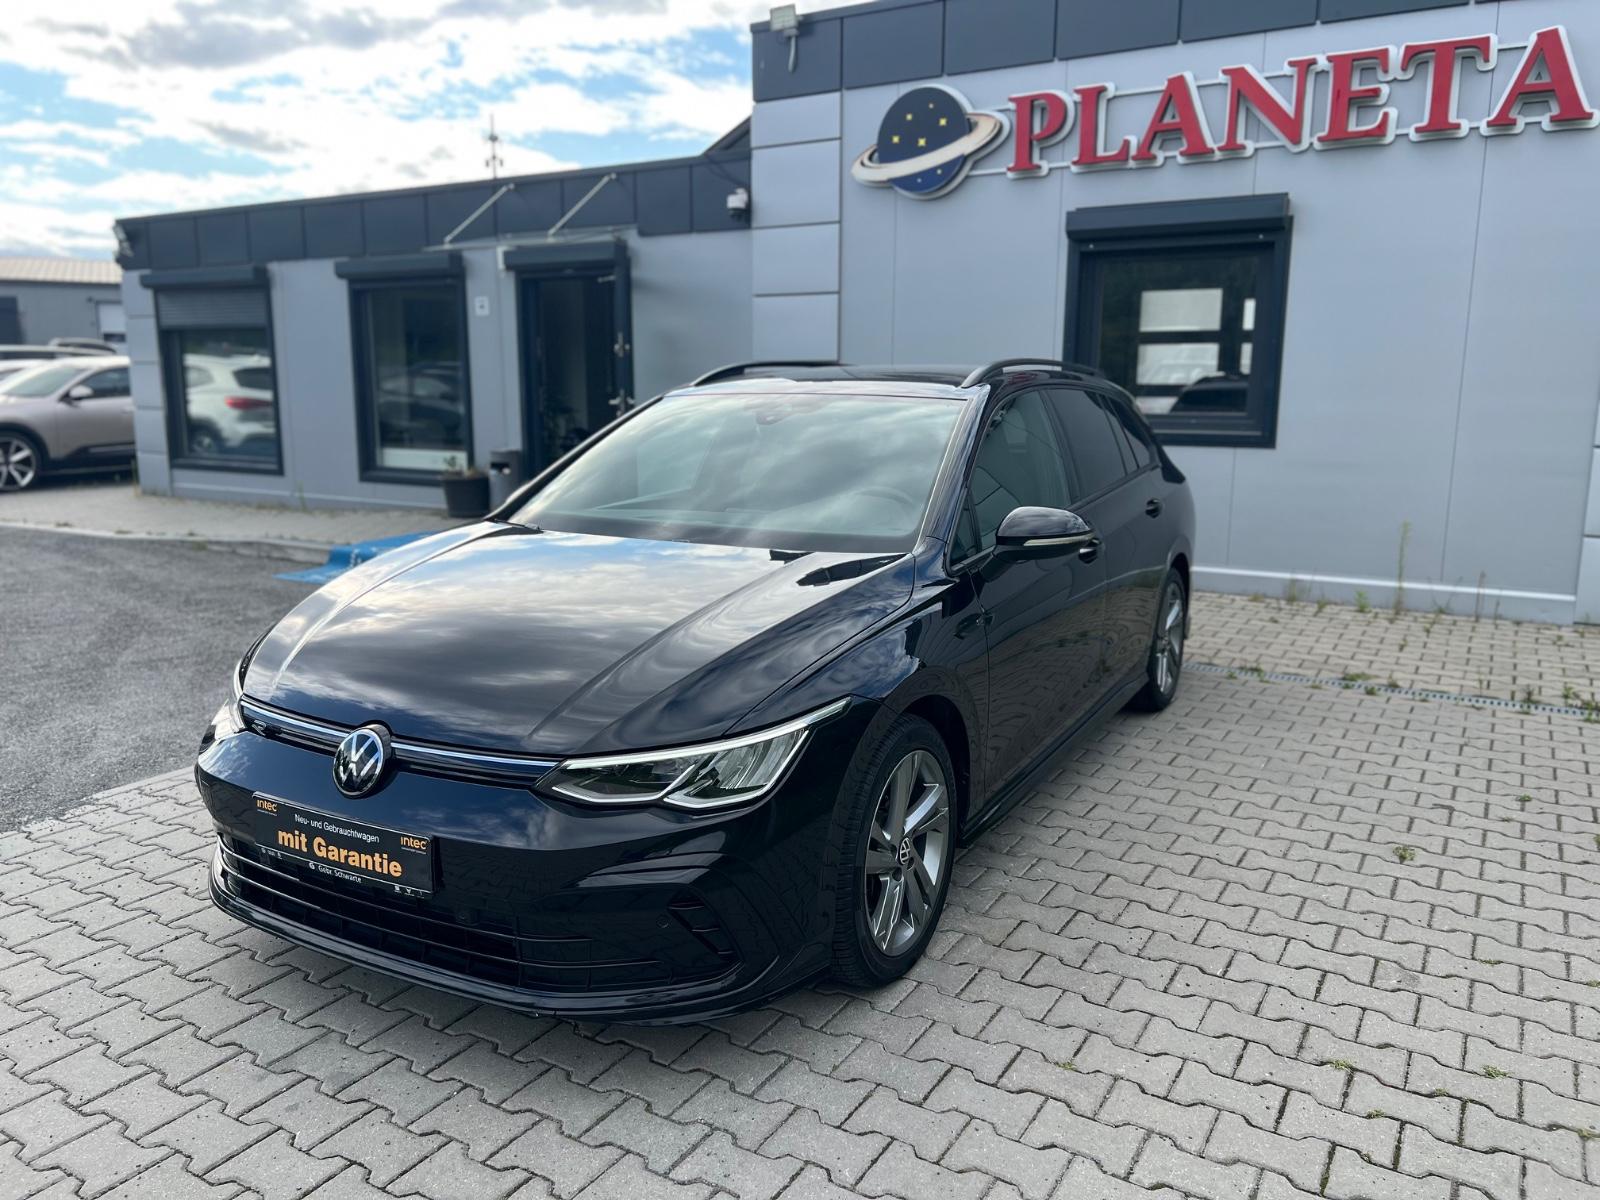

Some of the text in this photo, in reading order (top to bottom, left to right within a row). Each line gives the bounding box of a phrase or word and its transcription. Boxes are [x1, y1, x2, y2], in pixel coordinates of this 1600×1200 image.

[1006, 25, 1597, 174] PLANETA
[294, 813, 380, 843] Neu- und Gebrauchtwagen
[278, 829, 402, 877] mit Garantie
